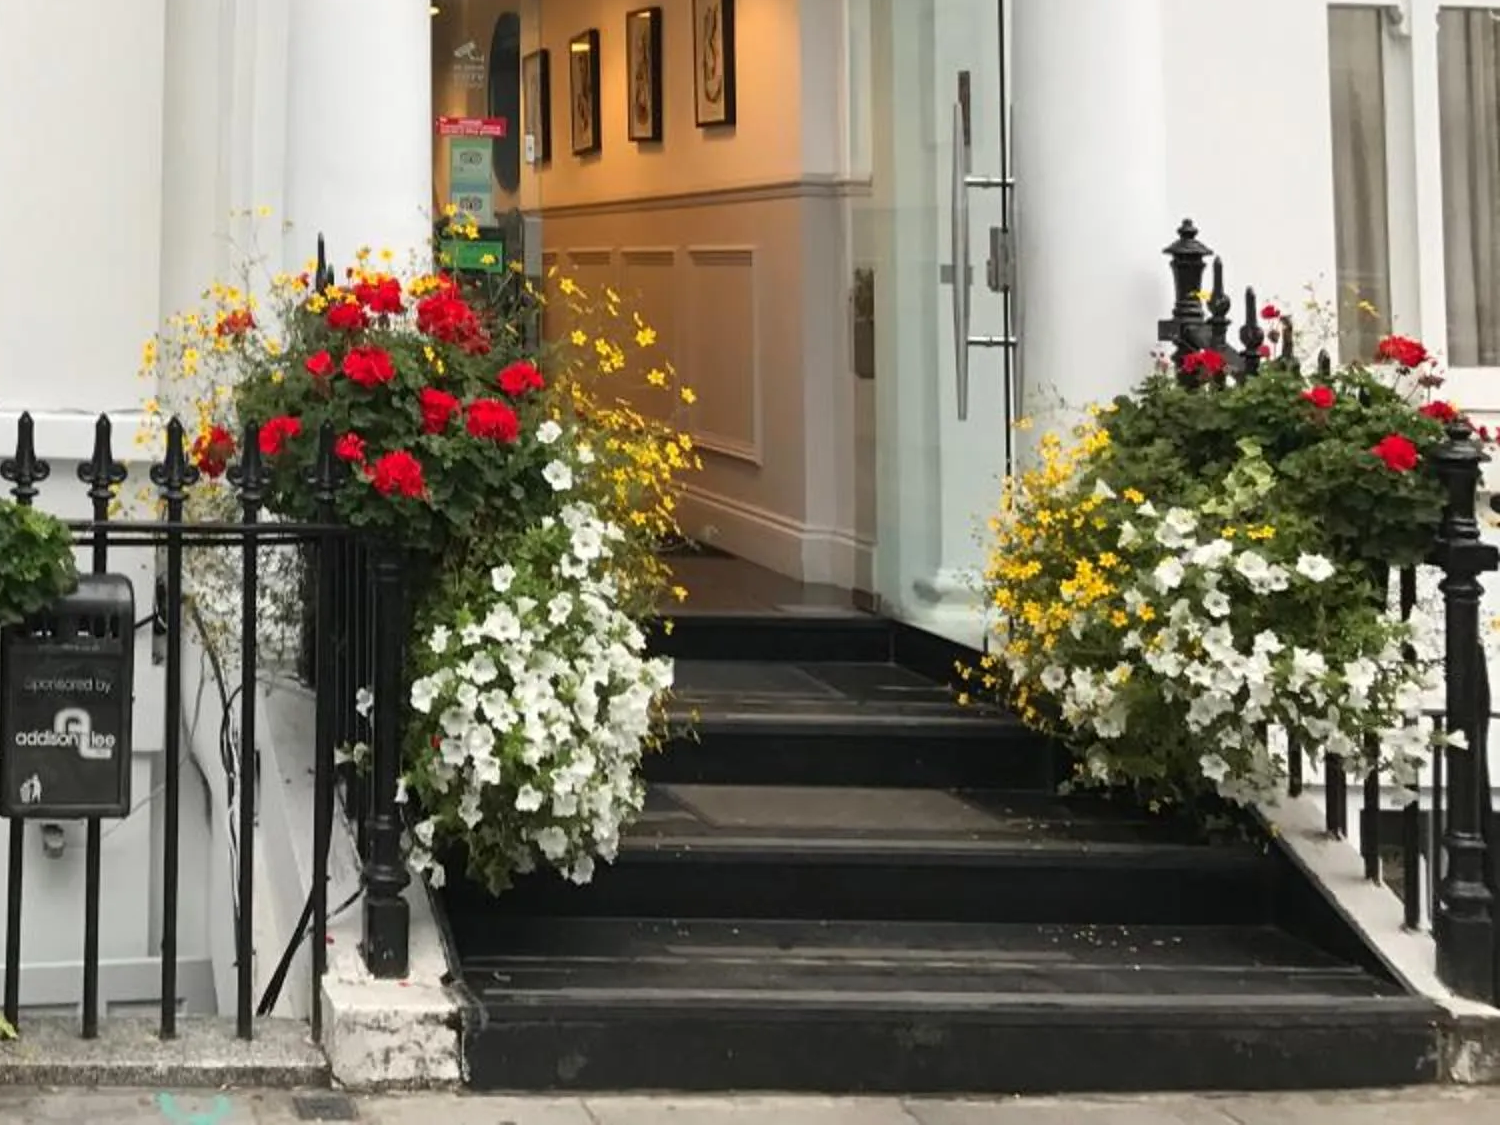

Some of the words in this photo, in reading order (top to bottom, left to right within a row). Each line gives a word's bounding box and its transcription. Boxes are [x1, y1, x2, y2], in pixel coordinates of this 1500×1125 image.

[96, 678, 112, 693] by
[15, 730, 79, 747] addison
[91, 731, 116, 748] lee
